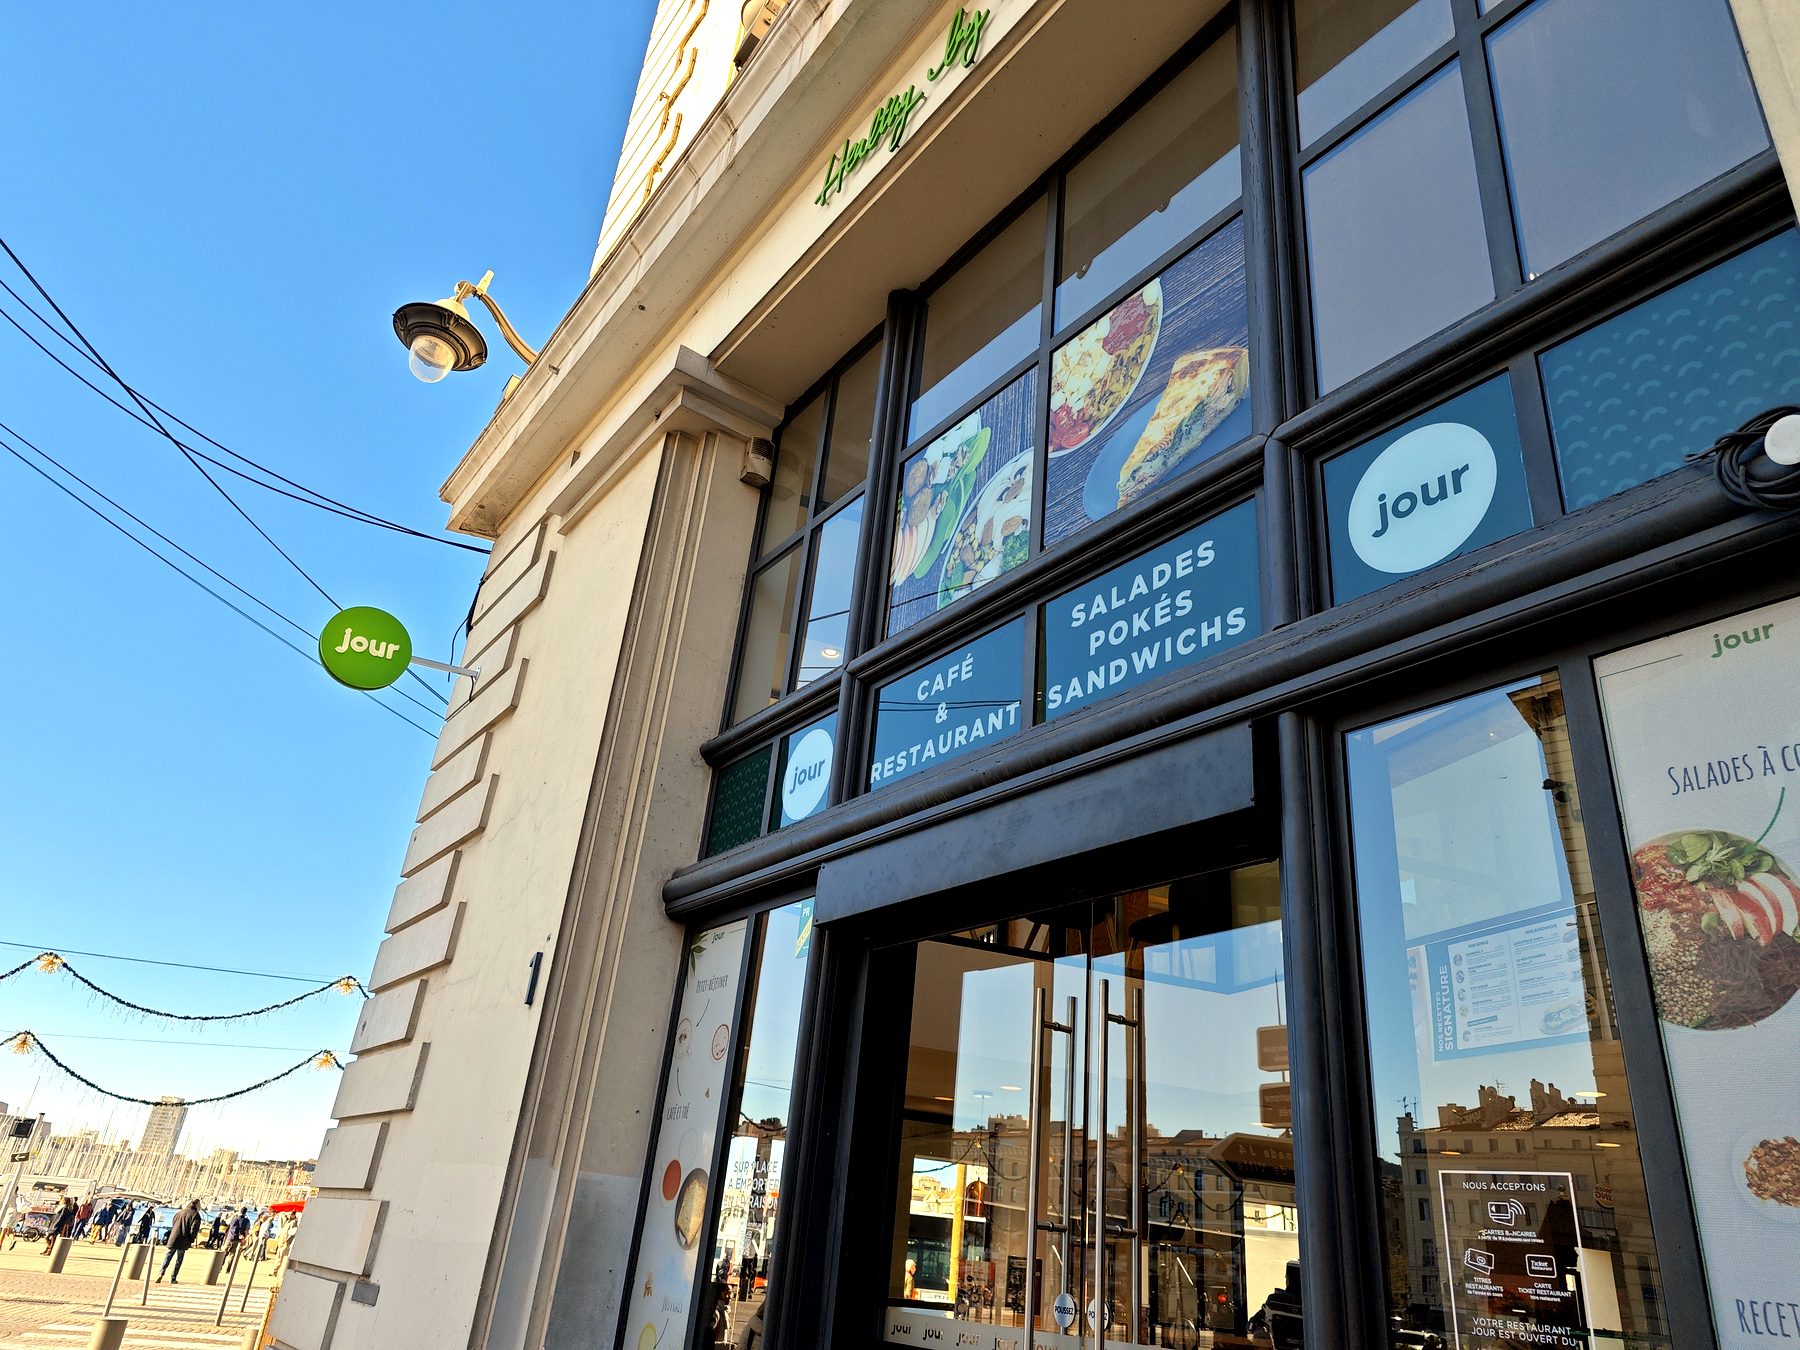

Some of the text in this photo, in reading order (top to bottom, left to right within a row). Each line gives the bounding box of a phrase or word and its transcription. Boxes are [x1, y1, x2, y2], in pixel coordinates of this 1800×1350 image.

[927, 7, 990, 82] by
[1371, 463, 1470, 538] jour
[1071, 540, 1216, 628] SALADES
[1089, 589, 1194, 656] POKÉS
[334, 627, 400, 660] jour
[1711, 623, 1774, 658] jour
[1047, 606, 1247, 711] SANDWICHS
[916, 653, 974, 702] CAFÉ
[935, 702, 948, 723] &
[870, 702, 1021, 784] RESTAURANT
[789, 759, 826, 794] jour
[1667, 753, 1754, 796] SALADES
[1757, 745, 1776, 776] À
[711, 931, 725, 944] jour
[1439, 964, 1453, 1051] SIGNATURE
[735, 1178, 779, 1191] EMPORTER
[1462, 1181, 1546, 1192] NOUS ACCEPTONS
[1465, 1282, 1504, 1292] RESTAURANTS
[1536, 1289, 1572, 1298] RESTAURANT
[1054, 1305, 1074, 1316] POUSSEZ
[1472, 1317, 1572, 1336] VOTRE RESTAURANT
[1471, 1327, 1577, 1347] JOUR EST OUVERT DU
